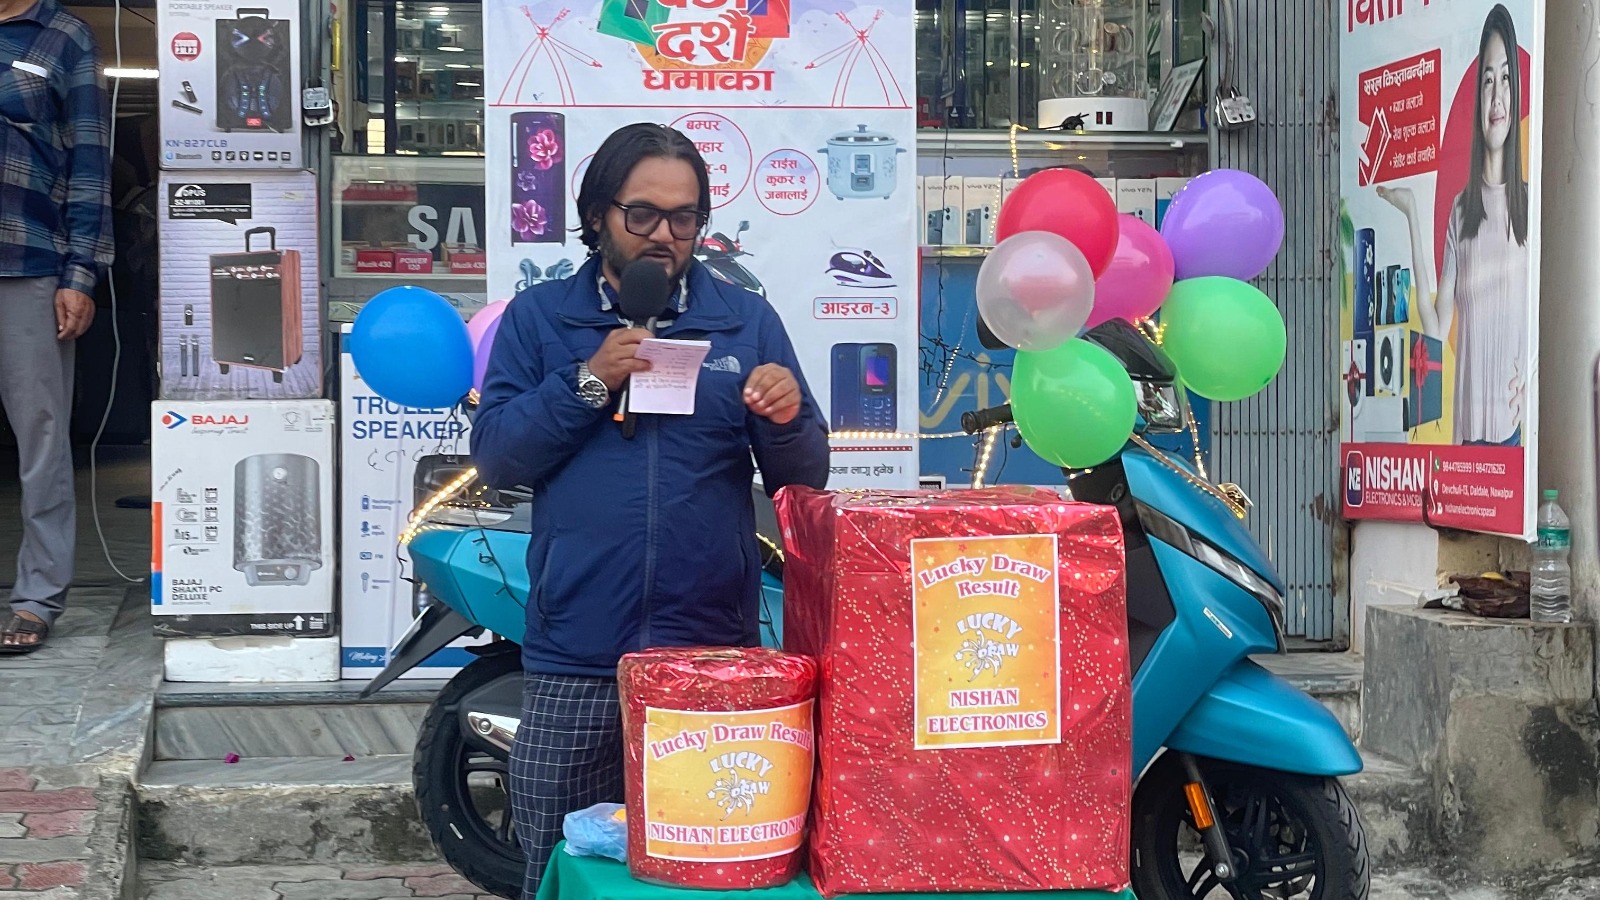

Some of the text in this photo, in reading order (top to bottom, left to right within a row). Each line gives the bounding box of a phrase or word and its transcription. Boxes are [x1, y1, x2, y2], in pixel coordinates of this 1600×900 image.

[642, 69, 775, 91] धमाका
[686, 120, 721, 131] बम्पर
[693, 142, 725, 152] पहार
[766, 175, 806, 186] कुकर २
[821, 302, 890, 316] आइरन-३
[192, 415, 249, 425] BAJAJ
[352, 420, 463, 440] SPEAKER
[1348, 467, 1361, 491] NE
[1365, 456, 1425, 492] NISHAN
[920, 555, 1049, 587] Lucky Draw
[958, 581, 1019, 597] Result
[955, 613, 1024, 640] LUCKY
[978, 642, 1019, 660] DRAW
[950, 688, 1018, 707] NISHAN
[927, 712, 1047, 733] ELECTRONICS
[650, 722, 811, 759] Lucky Draw Result
[709, 751, 773, 778] LUCKY
[731, 779, 771, 798] DRAW
[650, 823, 714, 843] NISHAN
